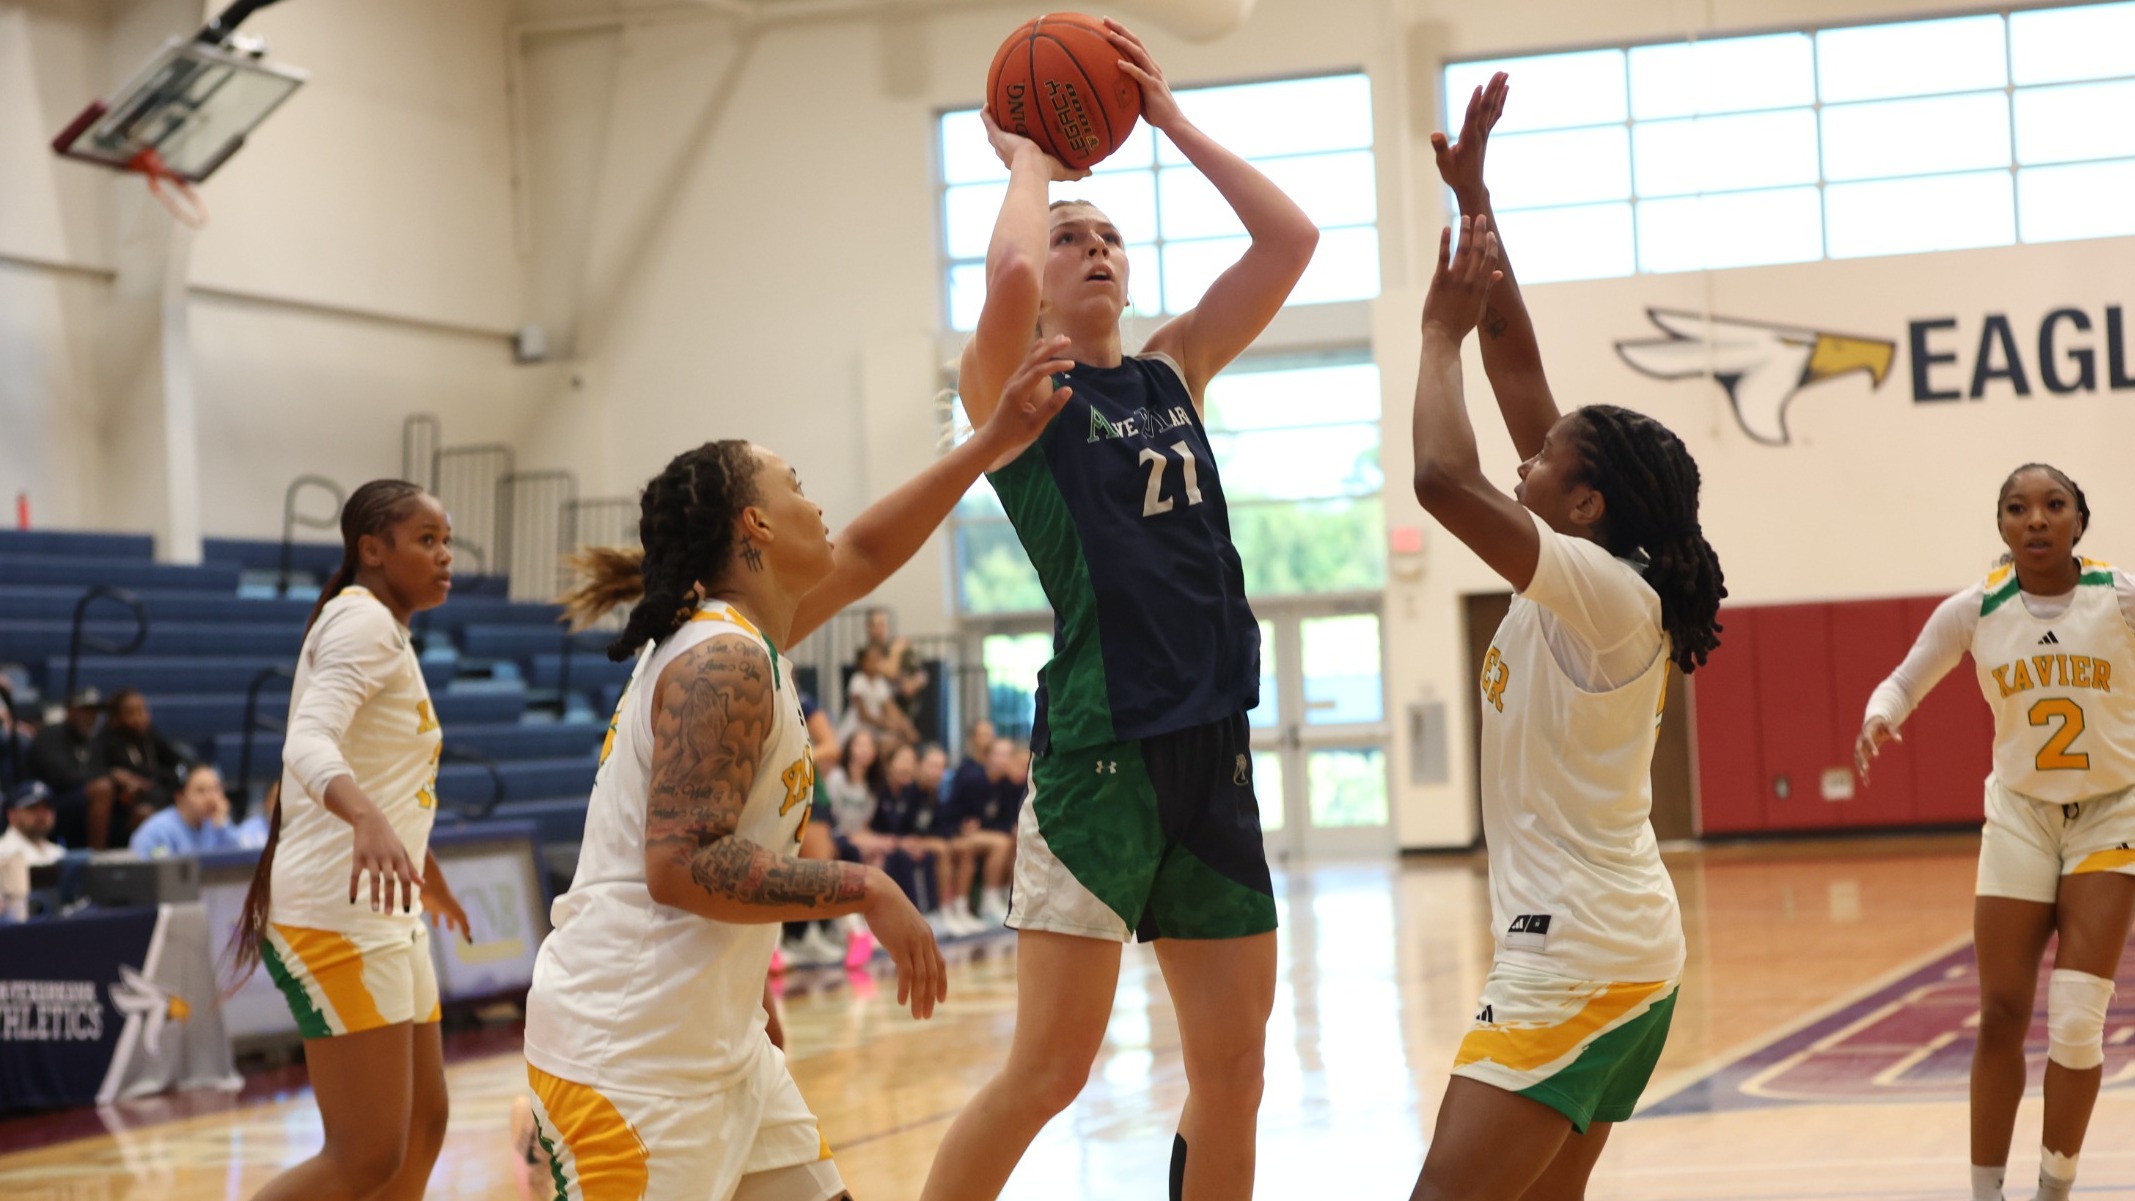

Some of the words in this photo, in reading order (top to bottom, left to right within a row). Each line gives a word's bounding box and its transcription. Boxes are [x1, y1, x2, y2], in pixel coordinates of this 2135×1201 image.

[1006, 83, 1028, 138] DING
[1045, 80, 1090, 159] LEGACY
[1139, 440, 1203, 518] 21
[1992, 654, 2111, 699] XAVIER
[2028, 697, 2090, 771] 2
